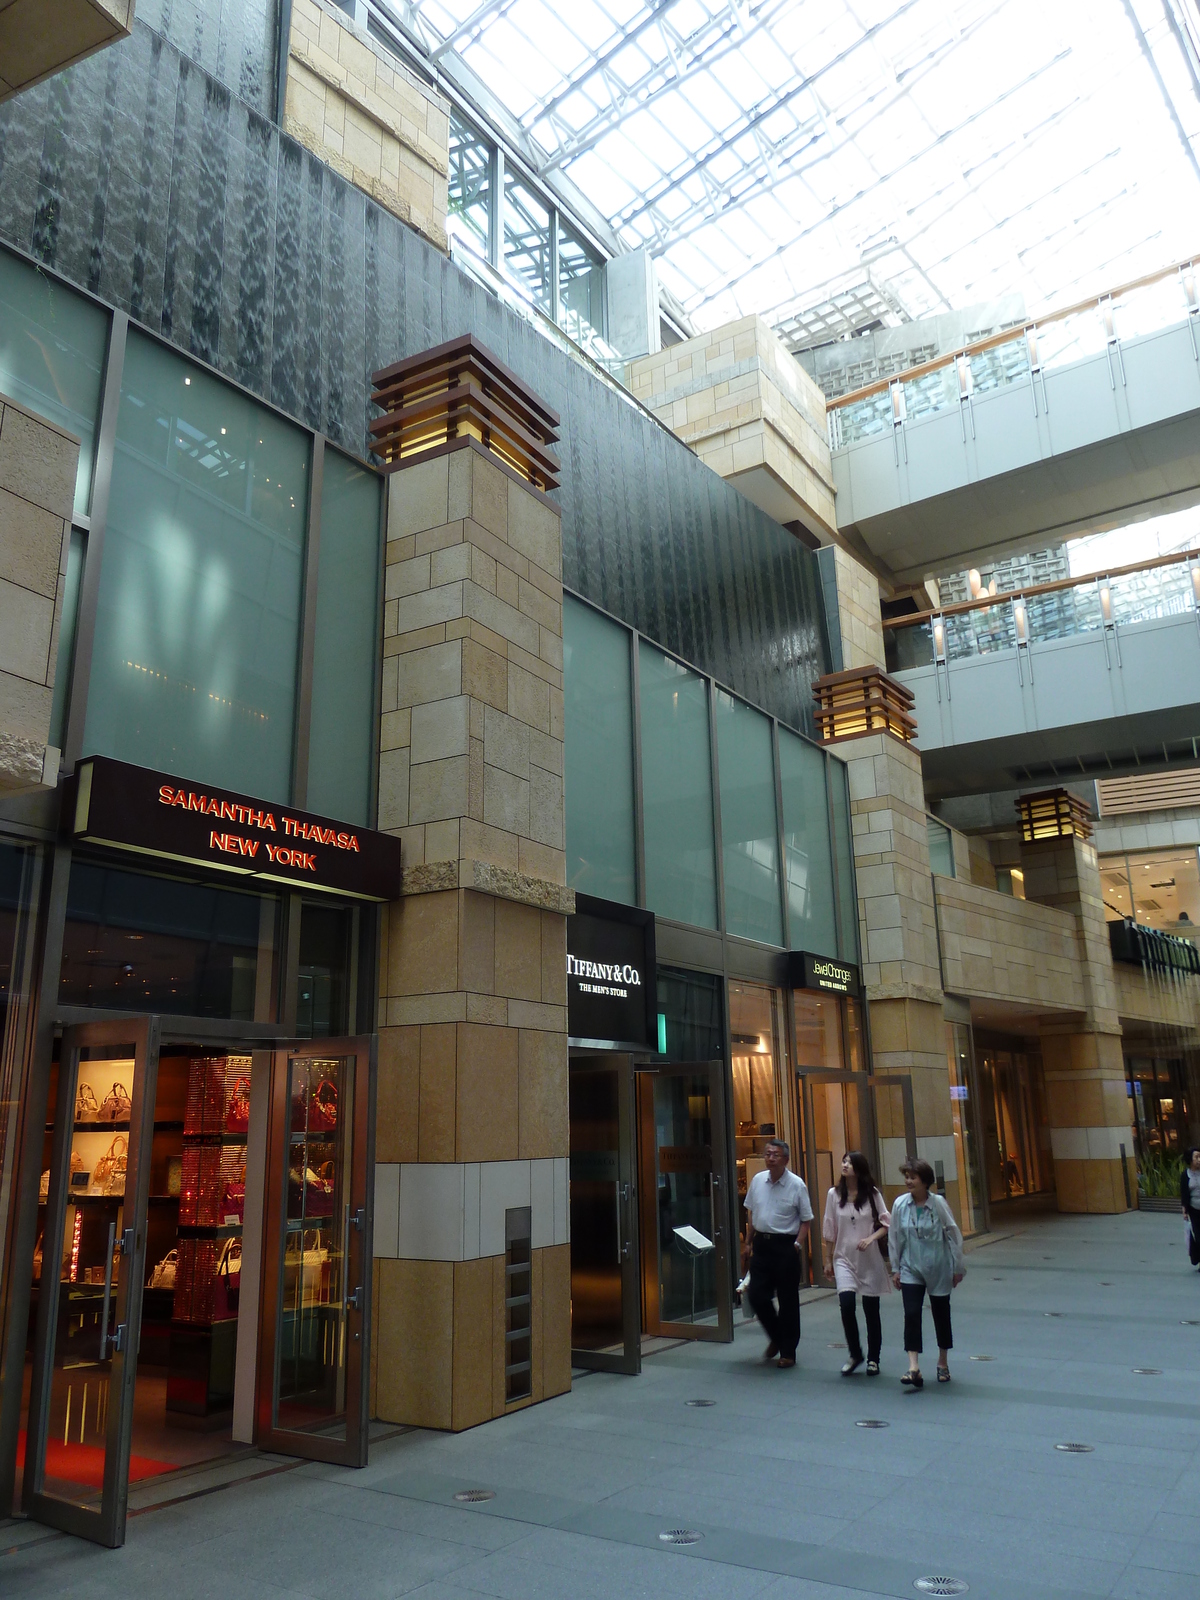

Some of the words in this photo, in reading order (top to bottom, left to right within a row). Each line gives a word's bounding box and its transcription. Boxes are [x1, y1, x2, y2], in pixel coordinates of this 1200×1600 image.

[158, 785, 277, 832] SAMANTHA
[281, 816, 360, 852] THAVASA
[209, 830, 259, 857] NEW
[265, 843, 316, 871] YORK
[579, 983, 592, 993] THE
[592, 985, 610, 995] MEN'S
[610, 988, 628, 998] STORE
